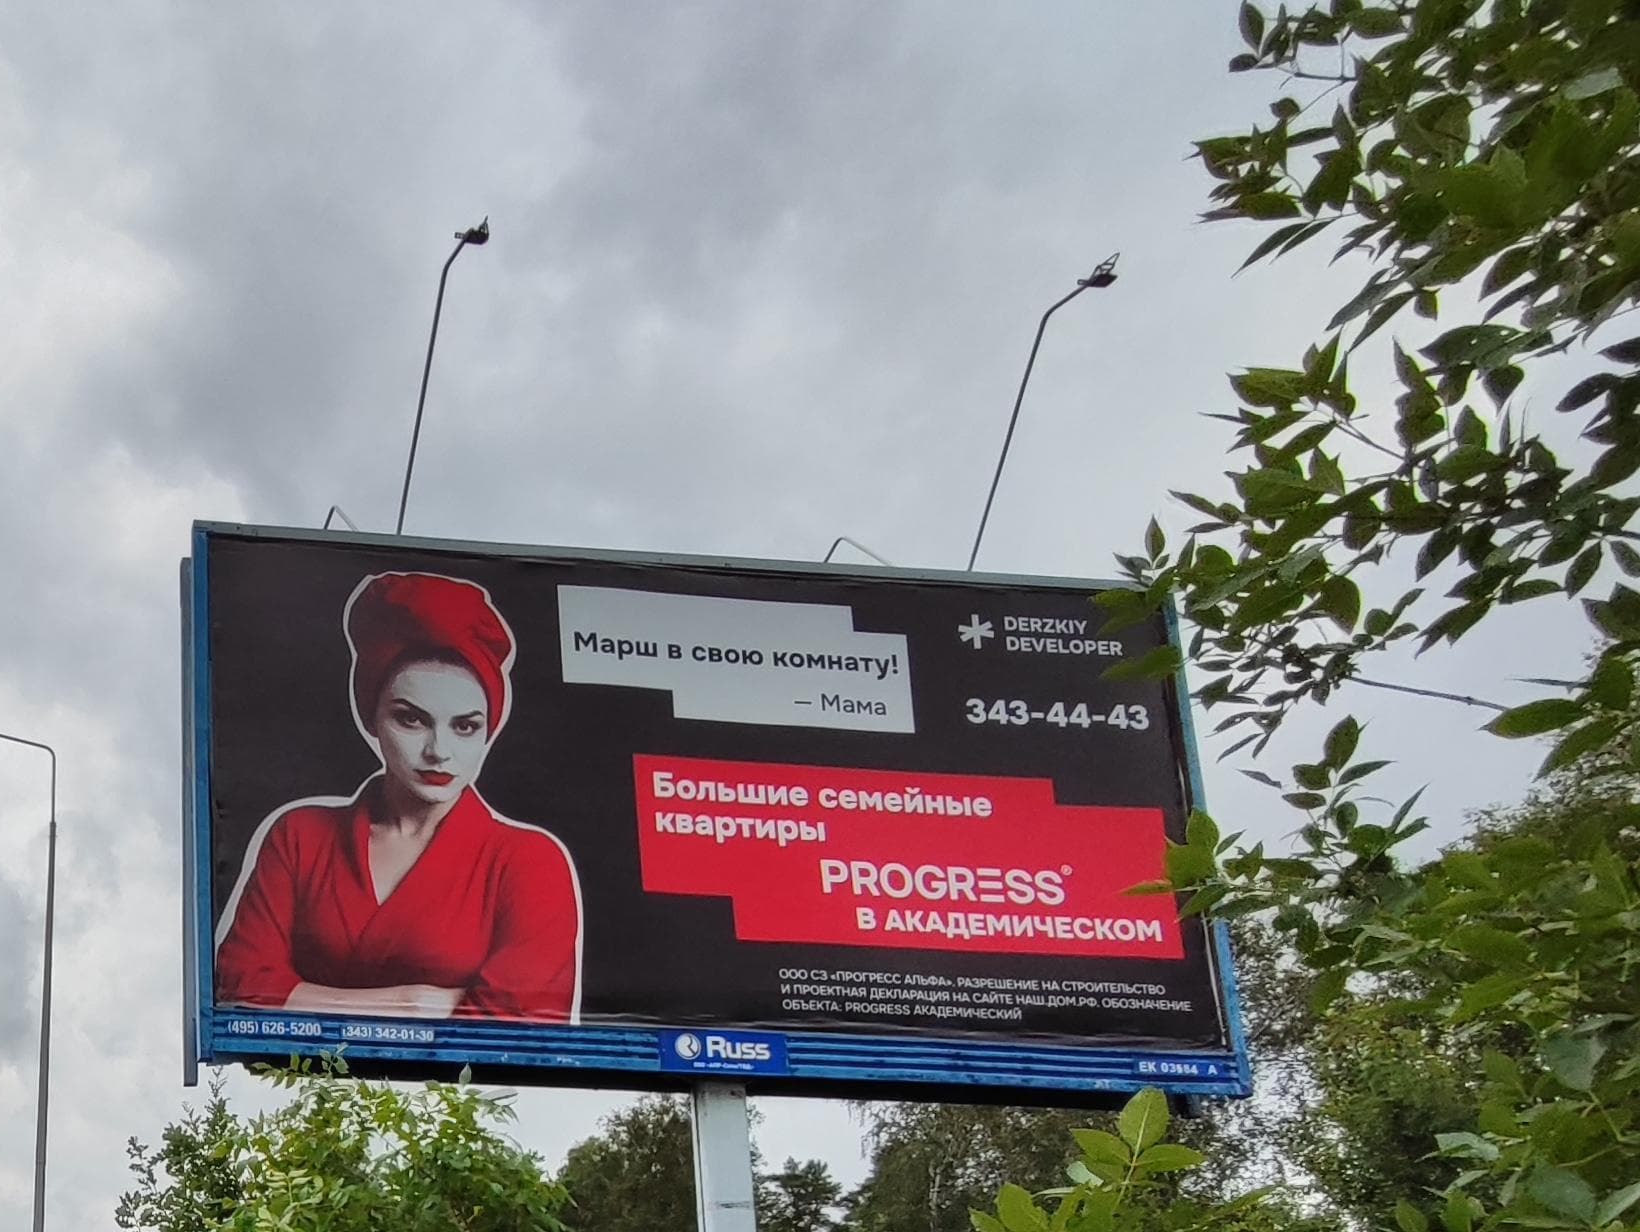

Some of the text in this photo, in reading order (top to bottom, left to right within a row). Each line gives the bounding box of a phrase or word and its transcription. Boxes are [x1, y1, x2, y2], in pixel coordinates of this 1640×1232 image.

[1004, 616, 1088, 635] DERZKIY
[573, 630, 900, 681] Марш в свою комнату!
[1006, 636, 1123, 656] DEVELOPER
[821, 692, 888, 717] Мама
[966, 698, 1150, 731] 343-44-43
[653, 771, 993, 818] Большие семейные
[655, 812, 827, 848] квартиры
[884, 910, 1164, 943] АКАДЕМИЧЕСКОМ
[778, 968, 808, 981] ООО
[957, 976, 1040, 991] РАЗРЕШЕНИЕ
[1042, 979, 1060, 992] НА
[1061, 980, 1166, 996] СТРОИТЕЛЬСТВО
[780, 984, 791, 995] И
[793, 984, 867, 998] ПРОЕКТНАЯ
[869, 987, 950, 1003] ДЕКЛАРАЦИЯ
[952, 992, 970, 1003] НА
[971, 990, 1014, 1005] САЙТЕ
[1101, 996, 1193, 1012] ОБОЗНАЧЕНИЕ
[782, 999, 1022, 1020] ОБЪЕКТА: PROGRESS АКАДЕМИЧЕСКИЙ
[227, 1020, 322, 1037] (495) 626-5200
[342, 1025, 435, 1042] (343) 342-01-30
[705, 1035, 771, 1060] Russ
